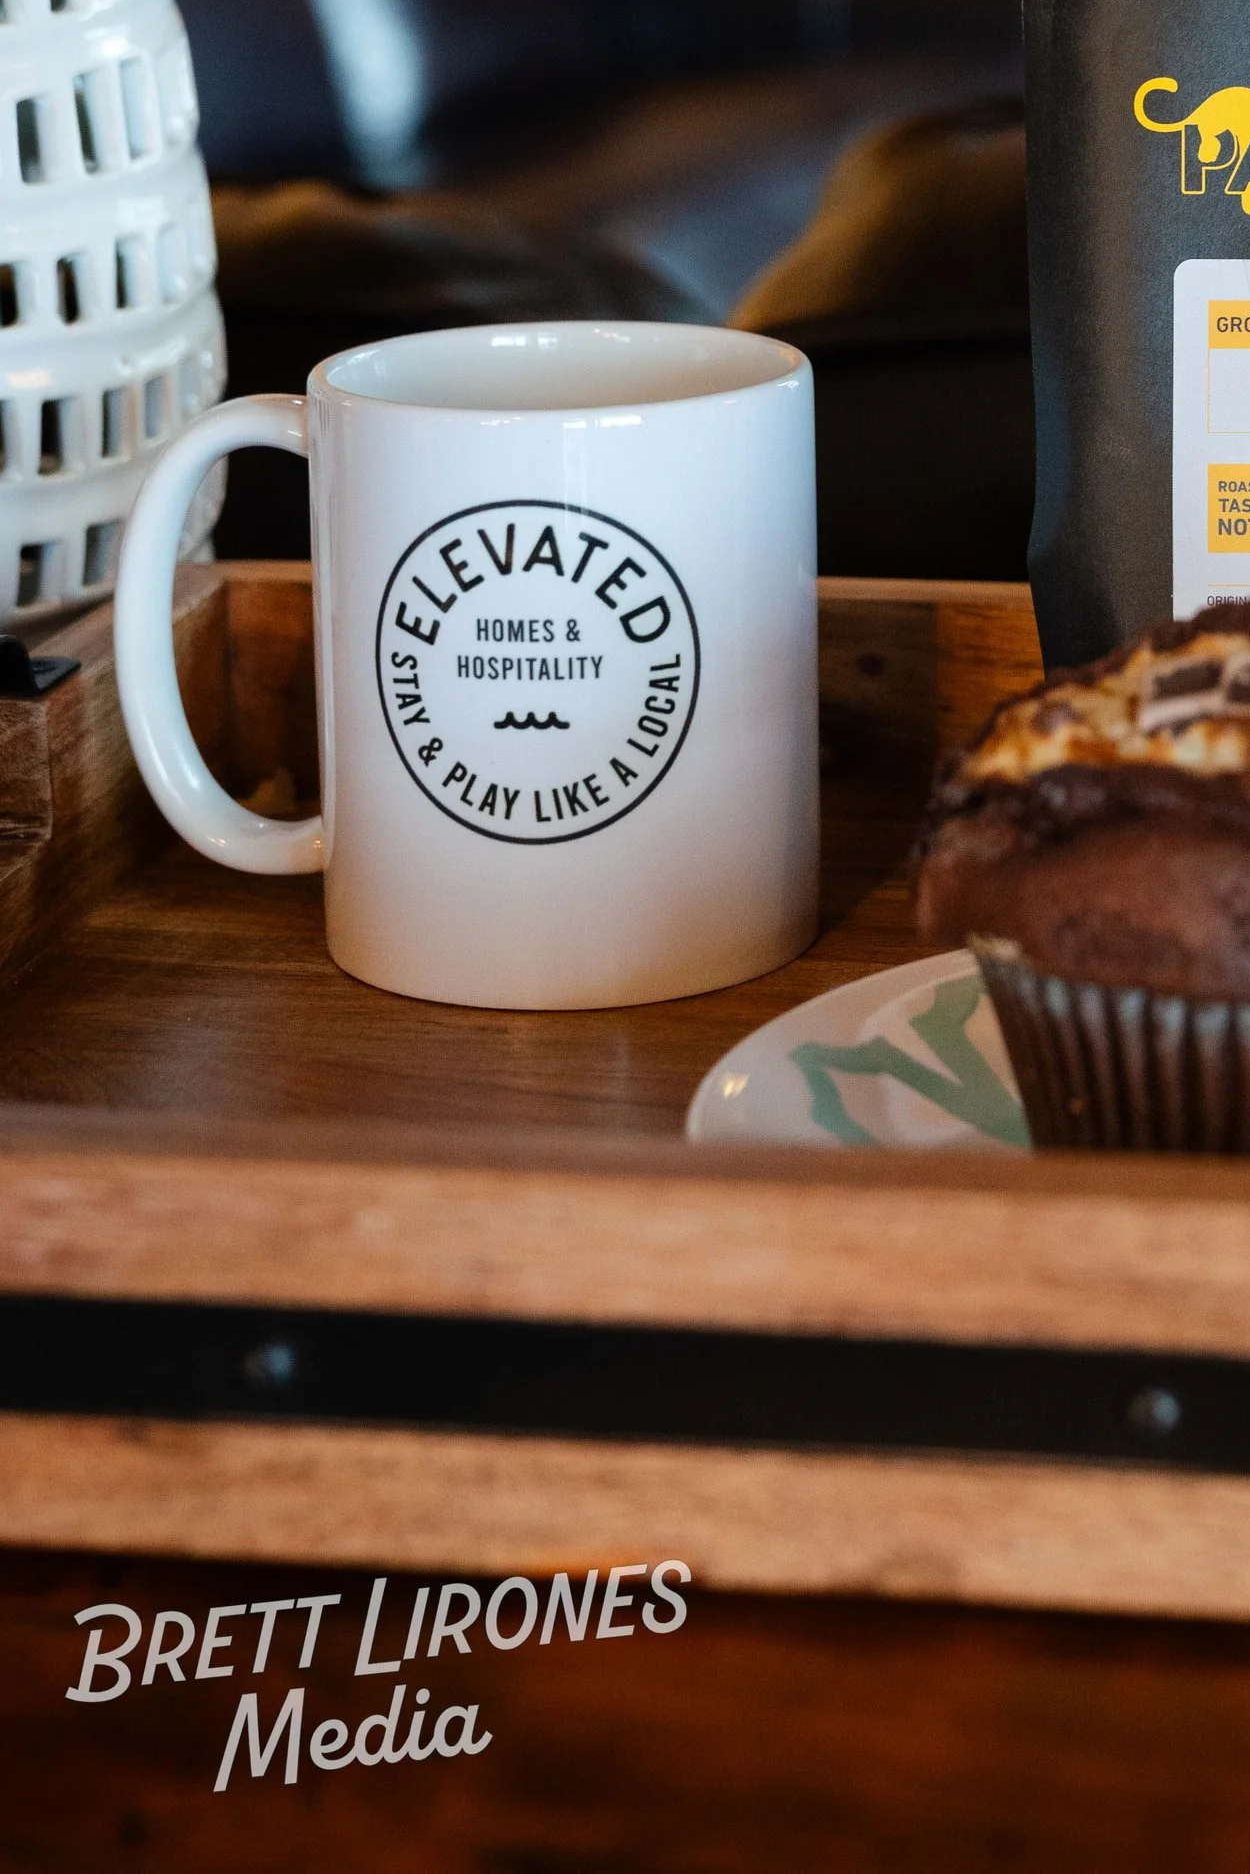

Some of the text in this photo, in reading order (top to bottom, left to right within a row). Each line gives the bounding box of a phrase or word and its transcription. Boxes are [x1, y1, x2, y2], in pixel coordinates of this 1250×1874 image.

[395, 523, 671, 645] ELEVATED
[476, 618, 581, 642] HOMES &
[457, 655, 603, 681] HOSPITALITY
[391, 651, 681, 823] STAY & PLAY LIKE A LOCAL
